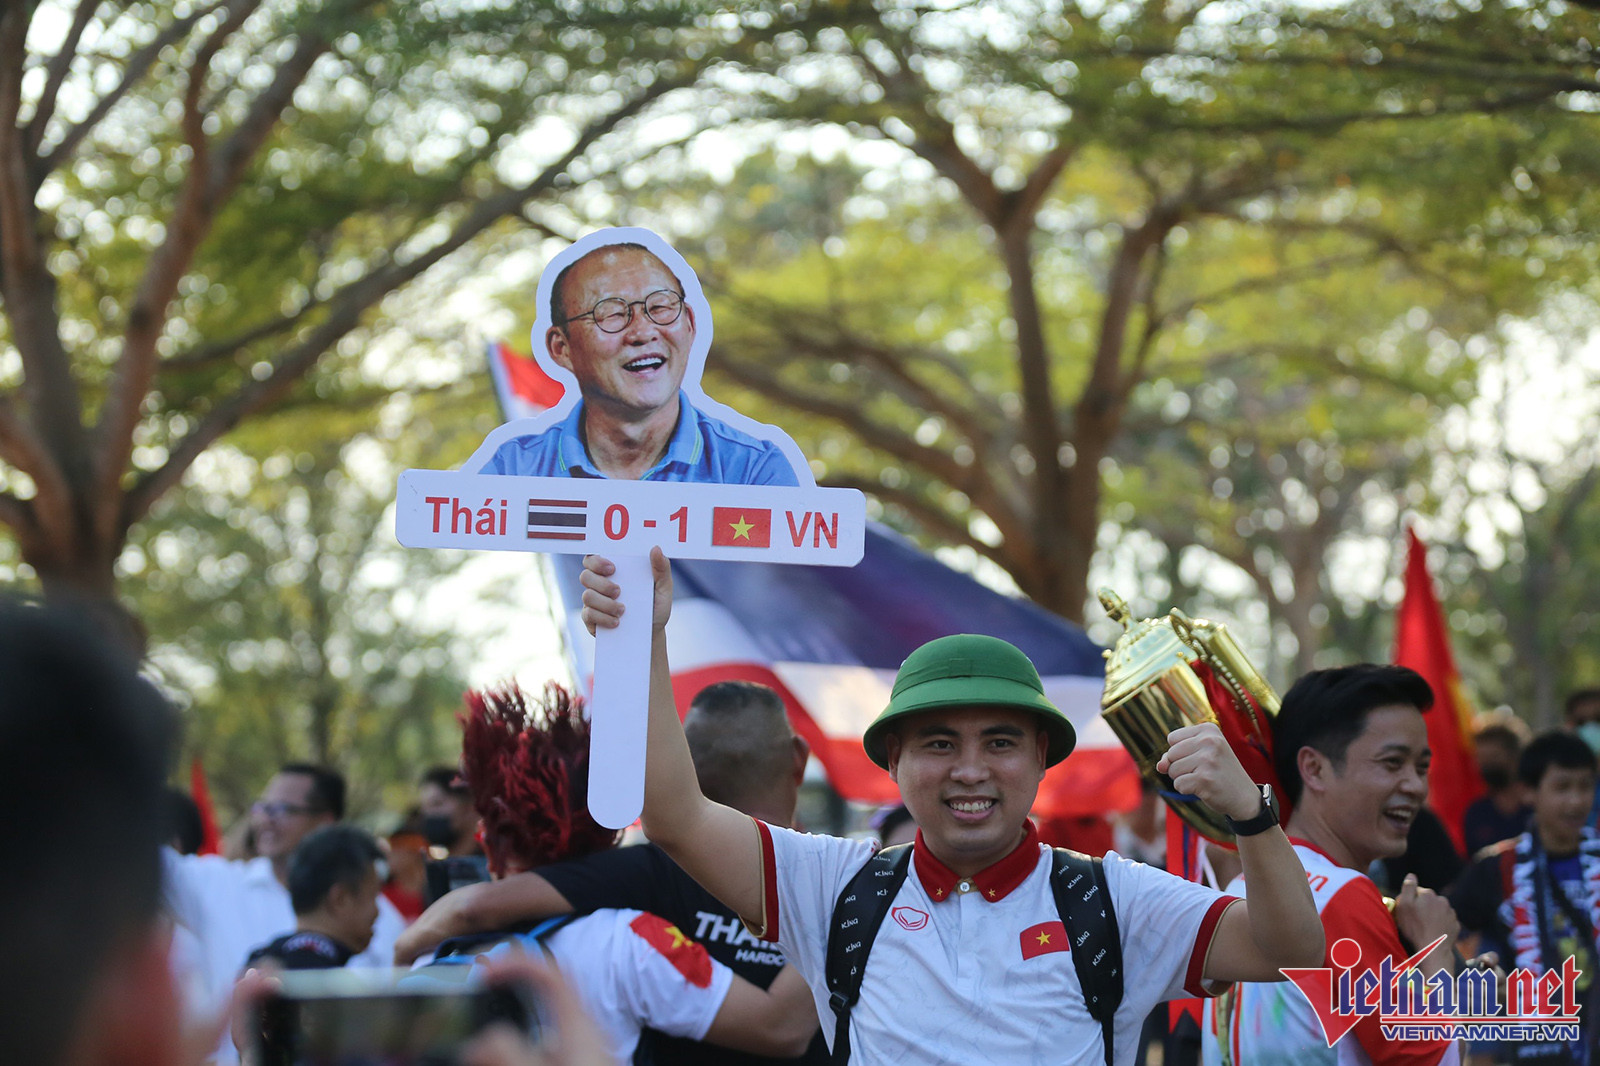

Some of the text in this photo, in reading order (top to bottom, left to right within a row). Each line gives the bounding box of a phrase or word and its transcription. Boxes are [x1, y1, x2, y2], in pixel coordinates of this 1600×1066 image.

[425, 496, 508, 536] Thái
[603, 504, 630, 541] 0
[669, 506, 689, 543] 1
[785, 510, 839, 549] VN
